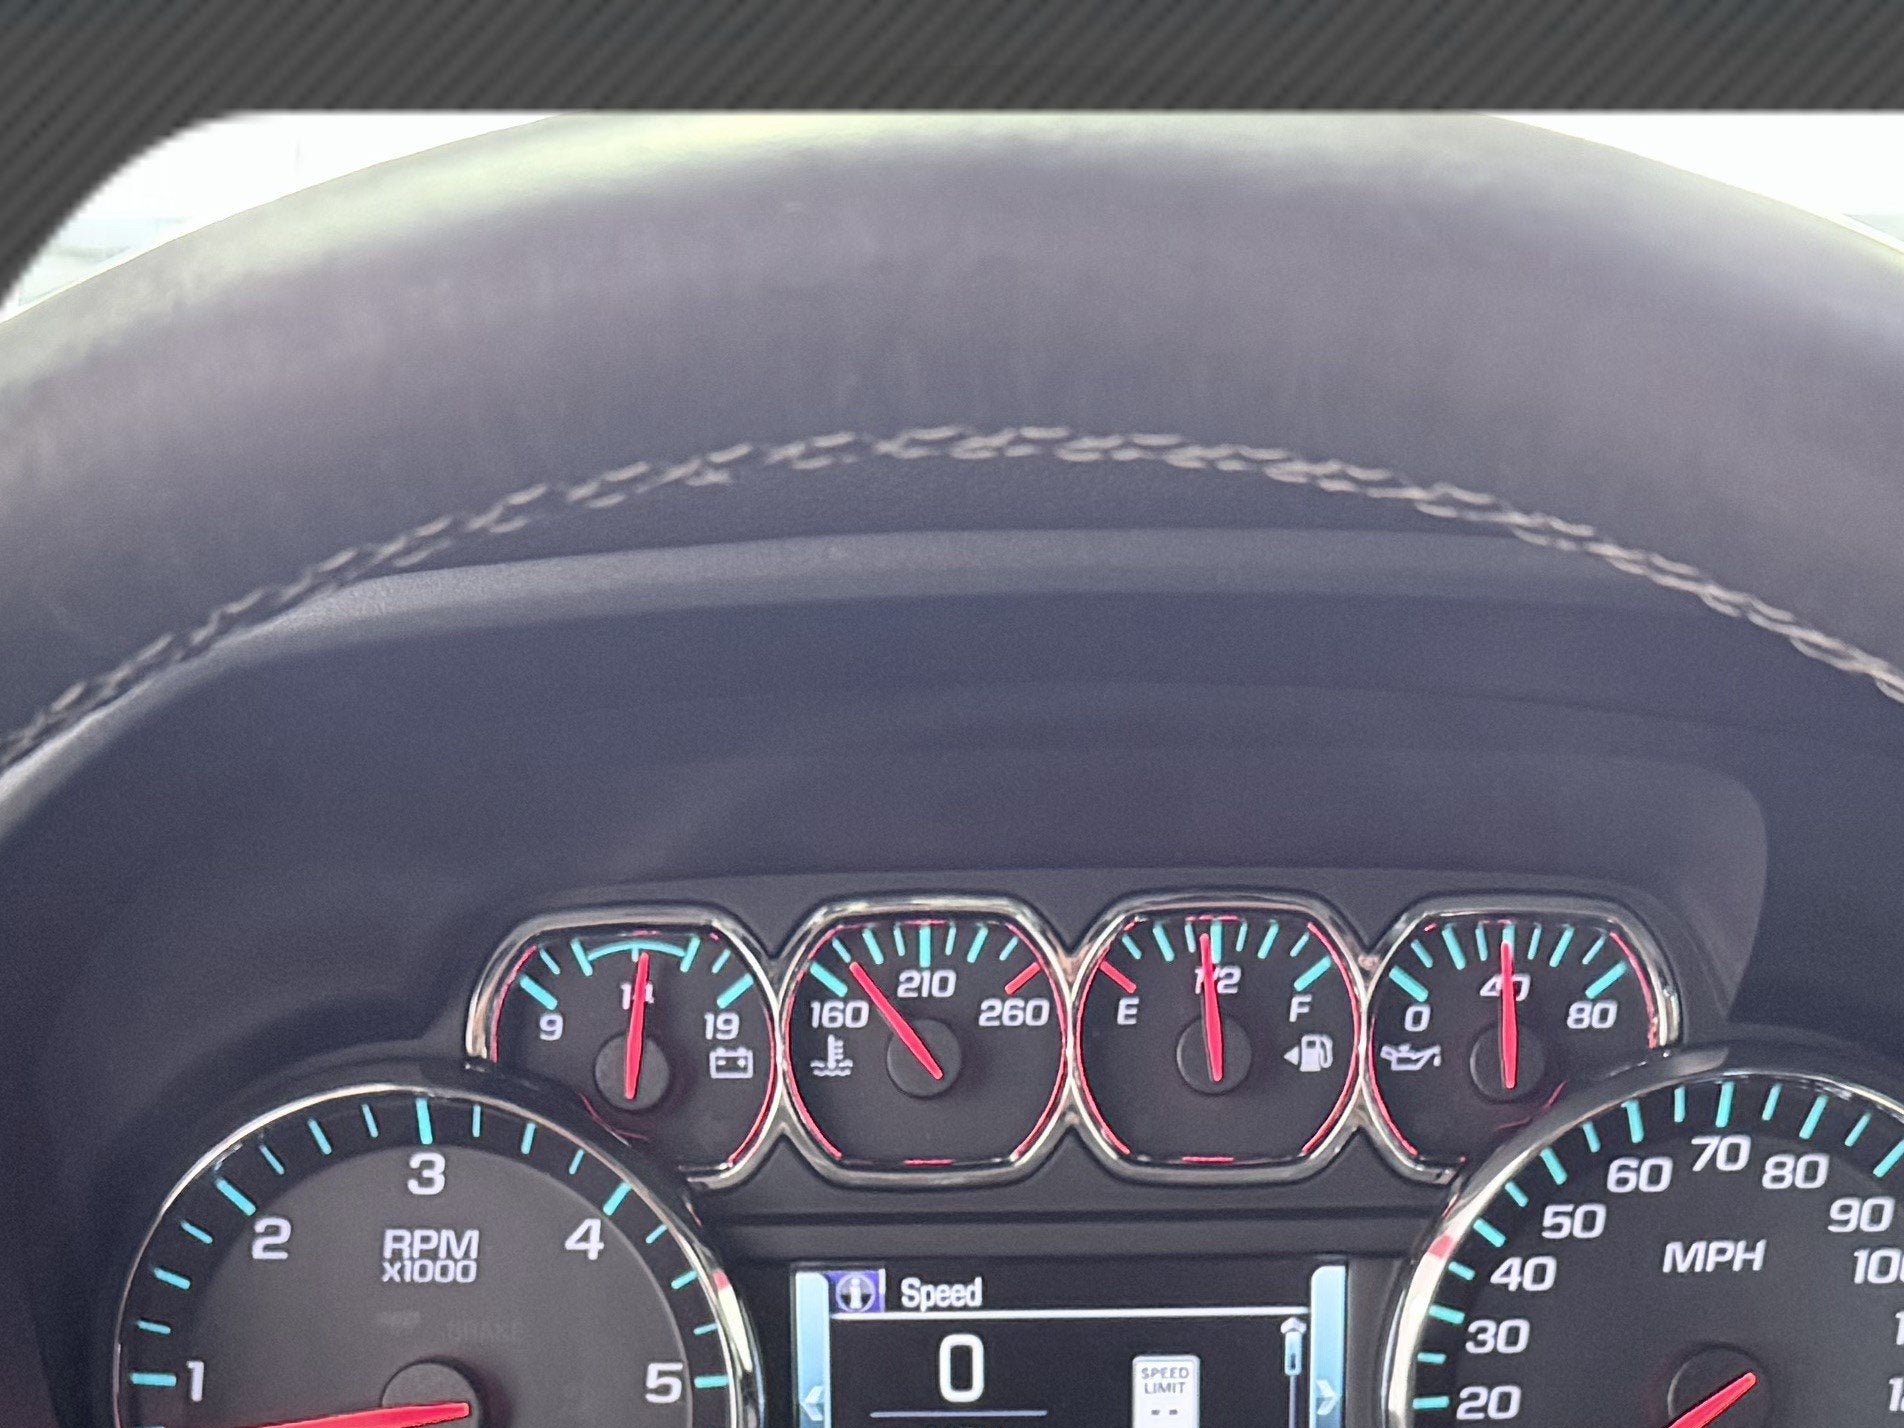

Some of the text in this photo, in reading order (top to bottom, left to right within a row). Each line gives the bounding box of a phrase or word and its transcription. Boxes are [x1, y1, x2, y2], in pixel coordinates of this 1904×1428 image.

[896, 969, 957, 998] 210
[1479, 972, 1531, 1002] 40
[539, 1012, 564, 1041] 9
[704, 1012, 740, 1040] 19
[810, 999, 870, 1029] 160
[978, 997, 1050, 1027] 260
[1116, 996, 1140, 1026] E
[1289, 994, 1312, 1023] F
[1404, 1004, 1431, 1032] 0
[1566, 1000, 1618, 1029] 80
[1691, 1134, 1751, 1172] 70
[407, 1152, 446, 1196] 3
[1606, 1156, 1673, 1193] 60
[1761, 1153, 1829, 1190] 80
[1541, 1203, 1607, 1240] 50
[1827, 1196, 1895, 1233] 90
[251, 1216, 292, 1260] 2
[382, 1228, 480, 1259] RPM
[564, 1218, 605, 1261] 4
[1662, 1239, 1767, 1273] MPH
[1489, 1256, 1557, 1292] 40
[900, 1276, 983, 1312] Speed
[1465, 1318, 1530, 1354] 30
[187, 1360, 205, 1402] 1
[645, 1362, 684, 1404] 5
[939, 1333, 985, 1403] 0
[1140, 1364, 1191, 1382] SPEED
[1142, 1379, 1187, 1396] LIMIT
[1456, 1385, 1522, 1421] 20
